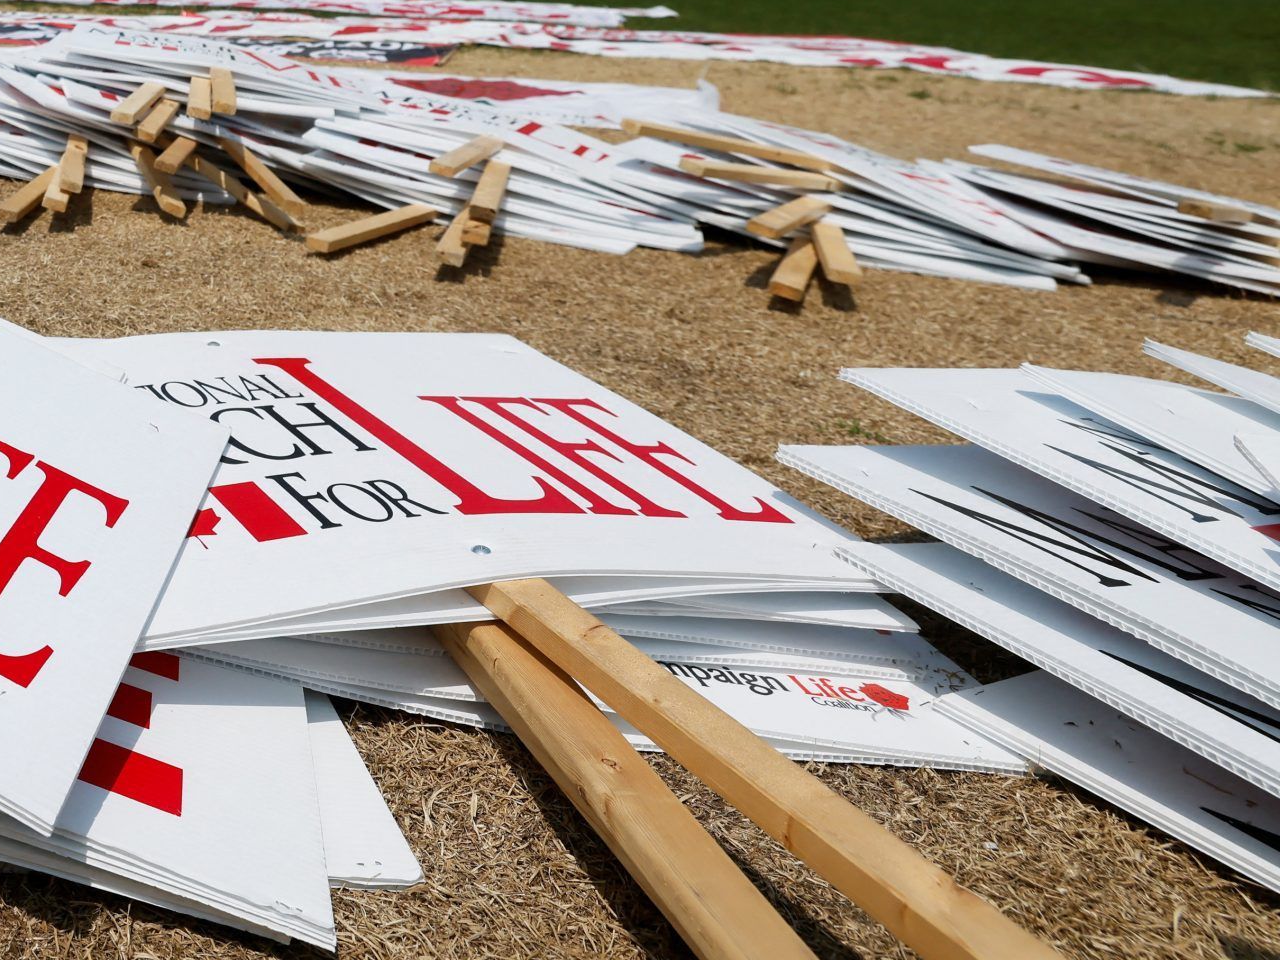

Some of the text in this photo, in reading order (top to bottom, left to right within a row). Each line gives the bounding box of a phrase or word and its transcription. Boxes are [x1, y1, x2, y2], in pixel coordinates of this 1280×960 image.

[134, 374, 304, 408] IONAL
[252, 357, 796, 526] LIFE
[265, 471, 450, 530] FOR
[787, 674, 866, 703] Life
[811, 696, 878, 714] Coalition
